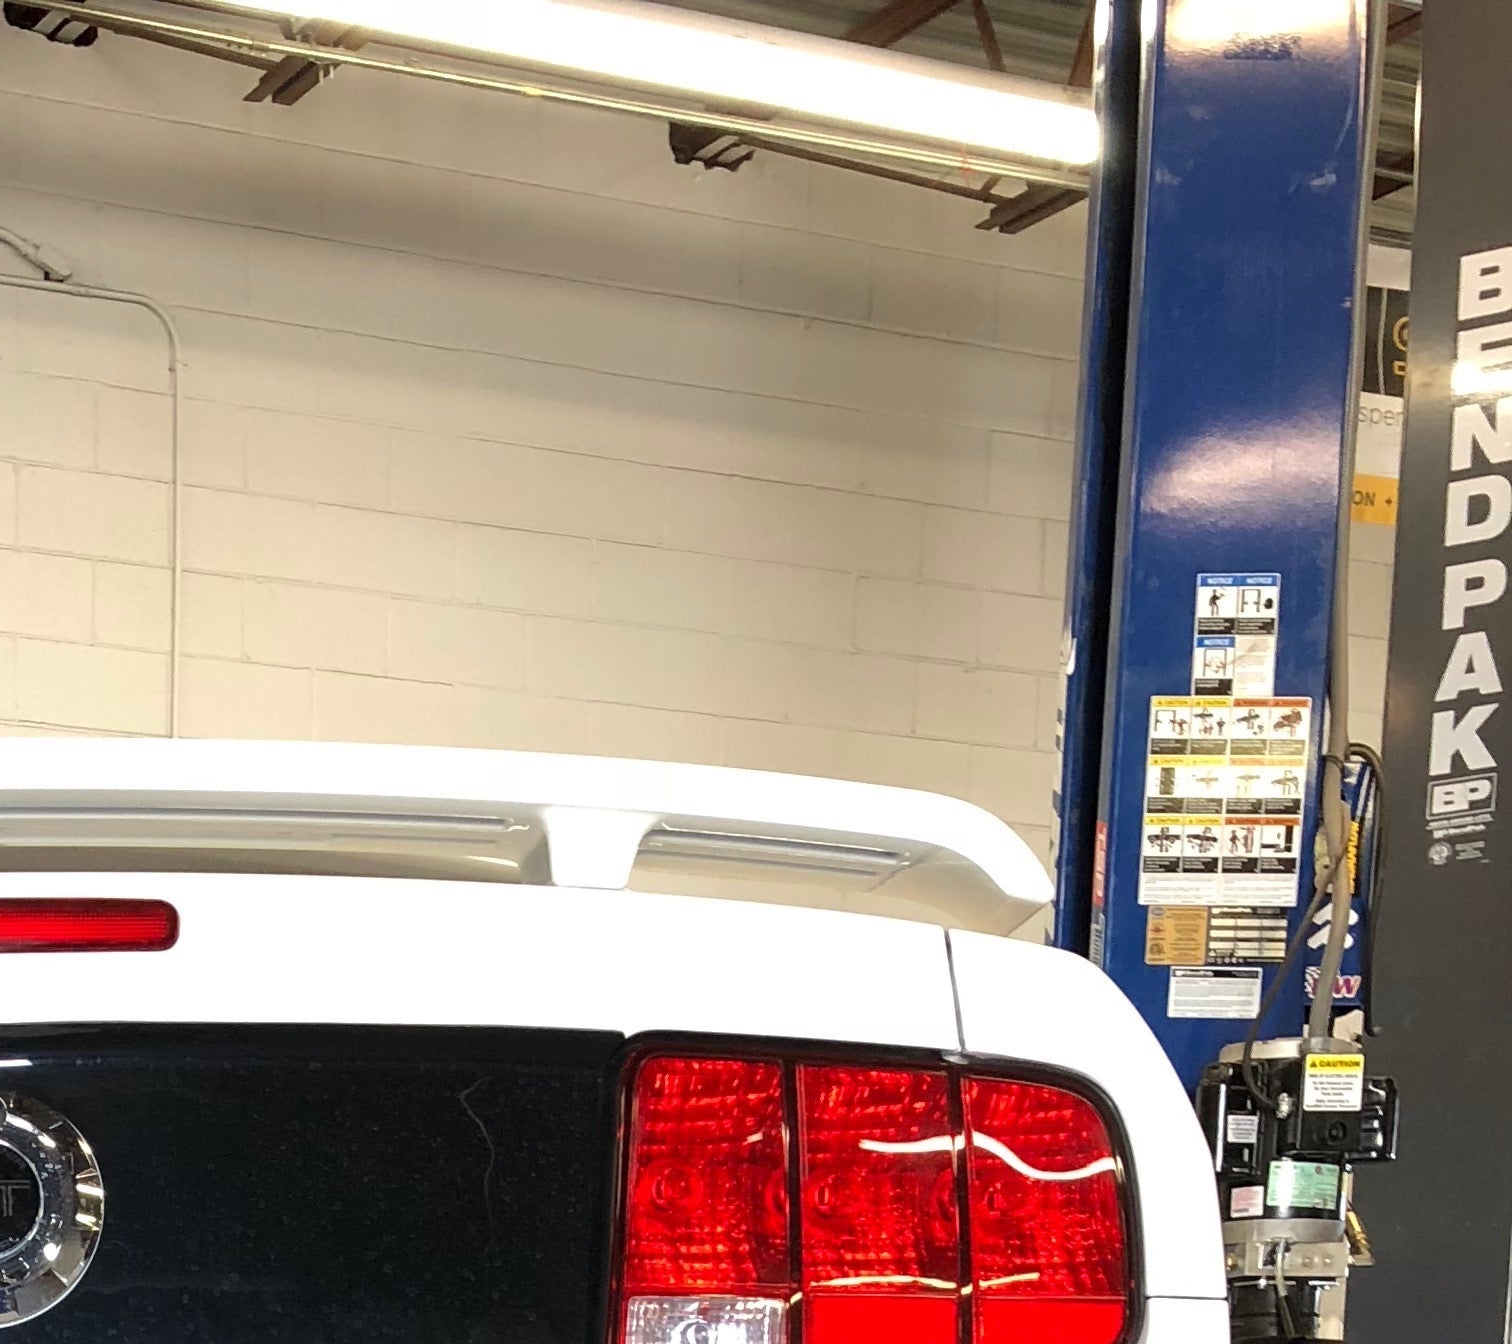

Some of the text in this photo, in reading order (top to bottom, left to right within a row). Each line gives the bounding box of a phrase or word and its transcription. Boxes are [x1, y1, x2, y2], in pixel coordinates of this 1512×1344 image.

[1429, 246, 1512, 773] BENDPAK
[1431, 779, 1492, 814] BP
[1319, 1060, 1360, 1068] CAUTION
